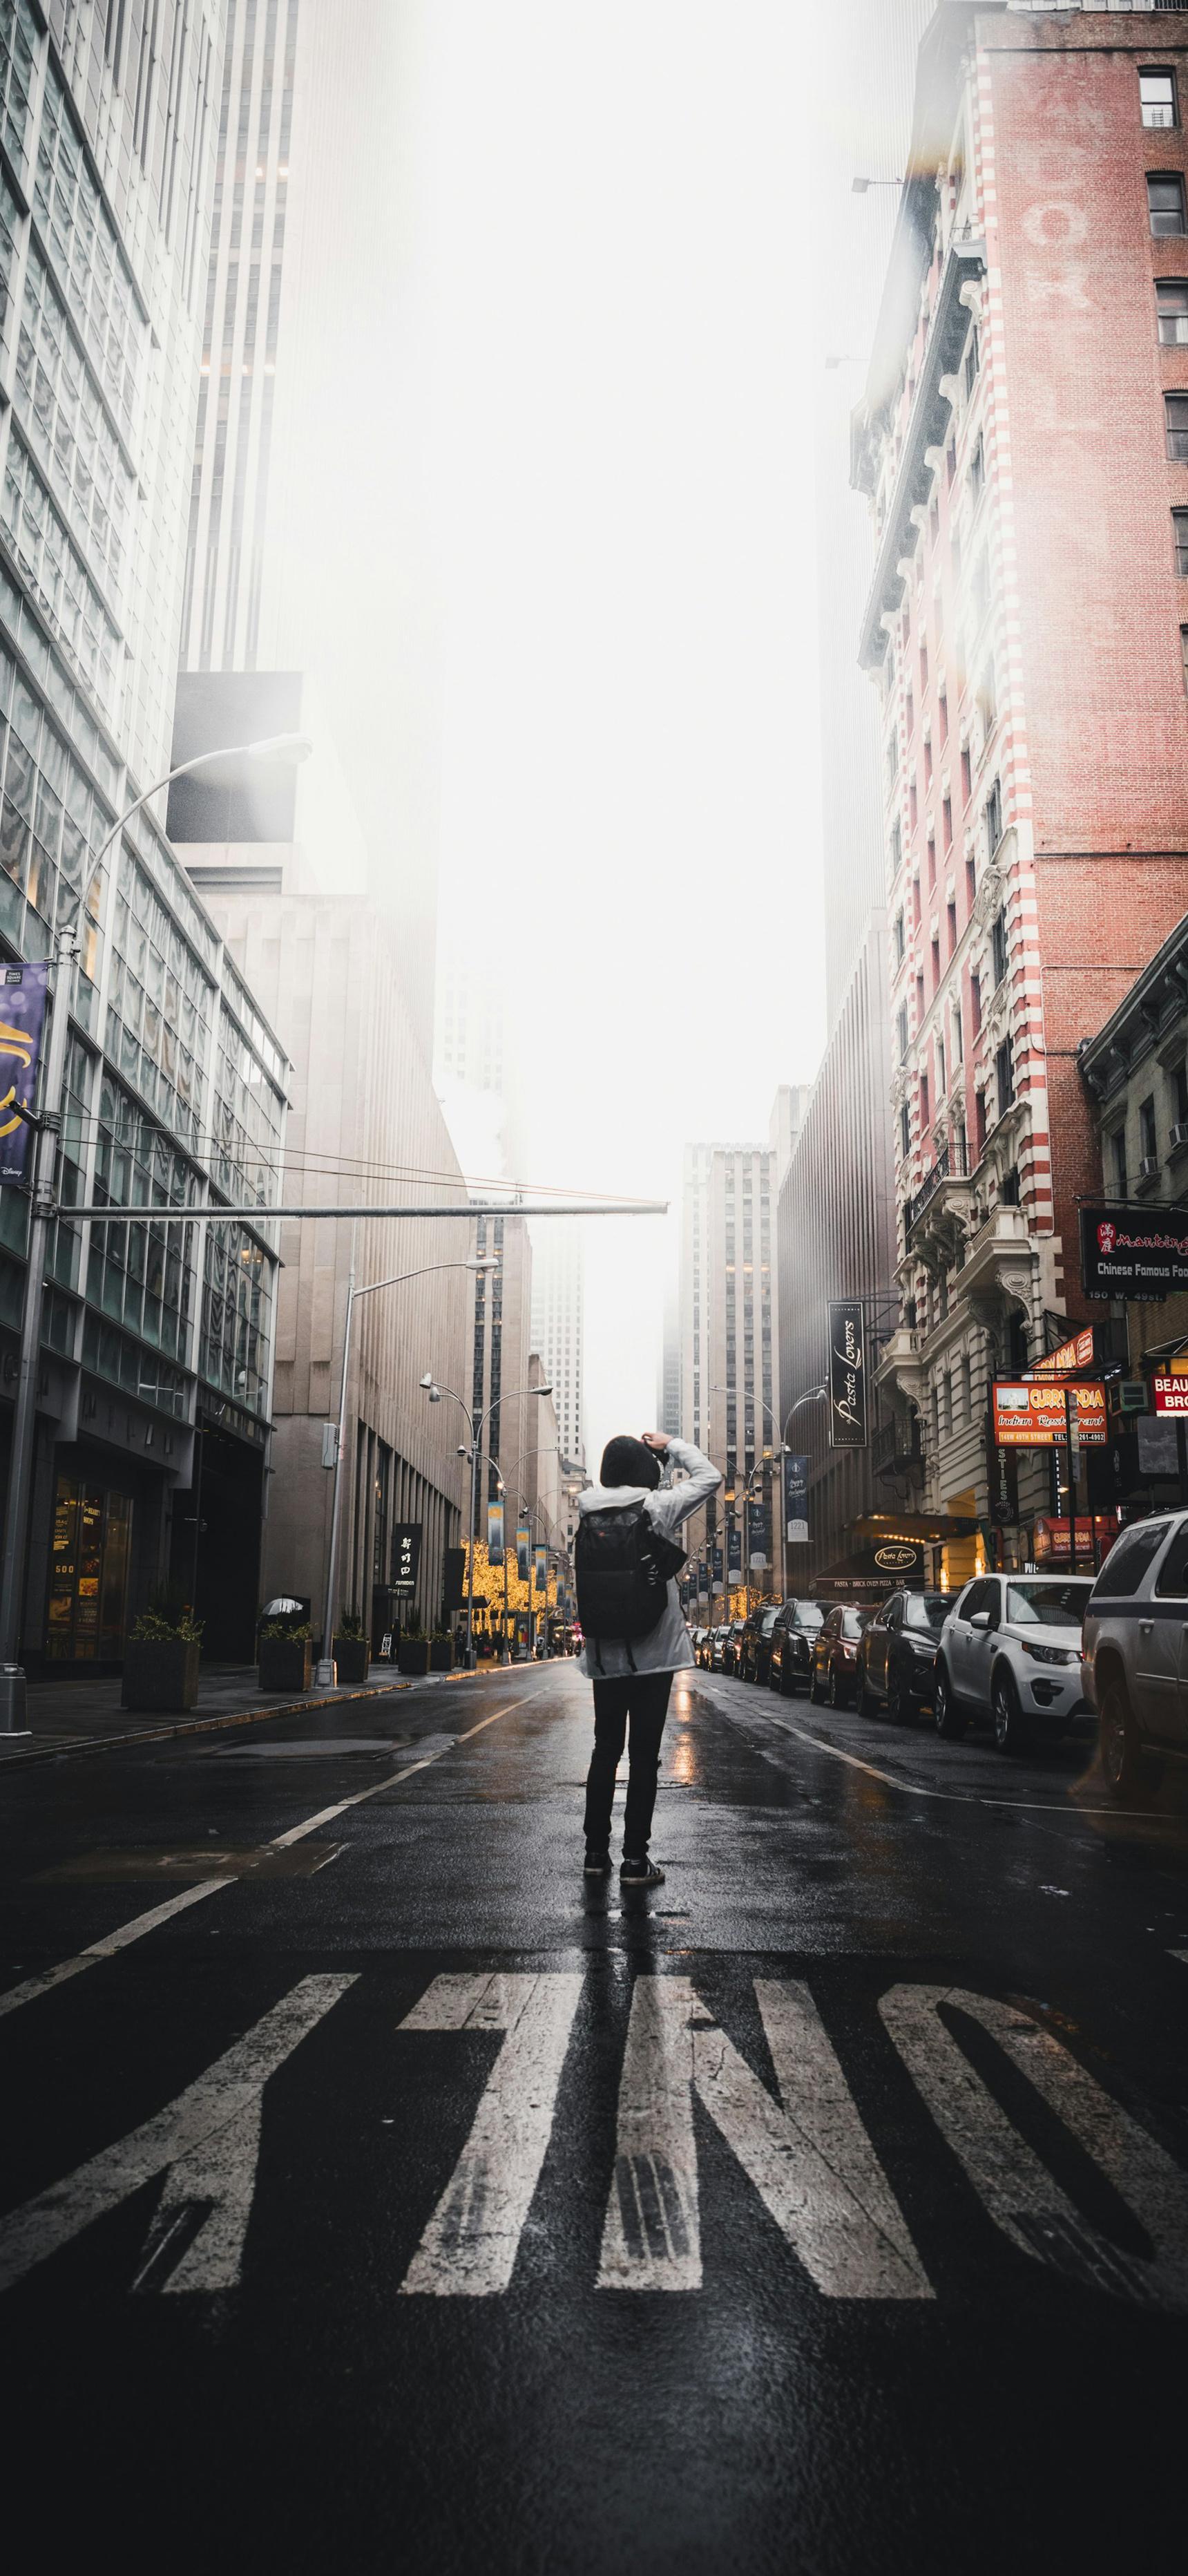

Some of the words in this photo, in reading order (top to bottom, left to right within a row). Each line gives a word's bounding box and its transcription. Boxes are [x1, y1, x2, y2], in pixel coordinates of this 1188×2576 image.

[1, 1166, 23, 1177] Disney
[1097, 1262, 1132, 1276] Chinese
[1135, 1264, 1170, 1276] Famous
[1089, 1291, 1108, 1299] 150
[1115, 1291, 1128, 1300] W.
[833, 1320, 863, 1370] Lovers
[1155, 1379, 1188, 1392] BEAU
[833, 1372, 862, 1427] Pasta
[1072, 1388, 1104, 1409] NDIA
[998, 1414, 1033, 1426] Indian
[1037, 1415, 1104, 1427] Restrant
[878, 1550, 896, 1562] Pasta
[0, 1973, 1188, 2304] ONLY
